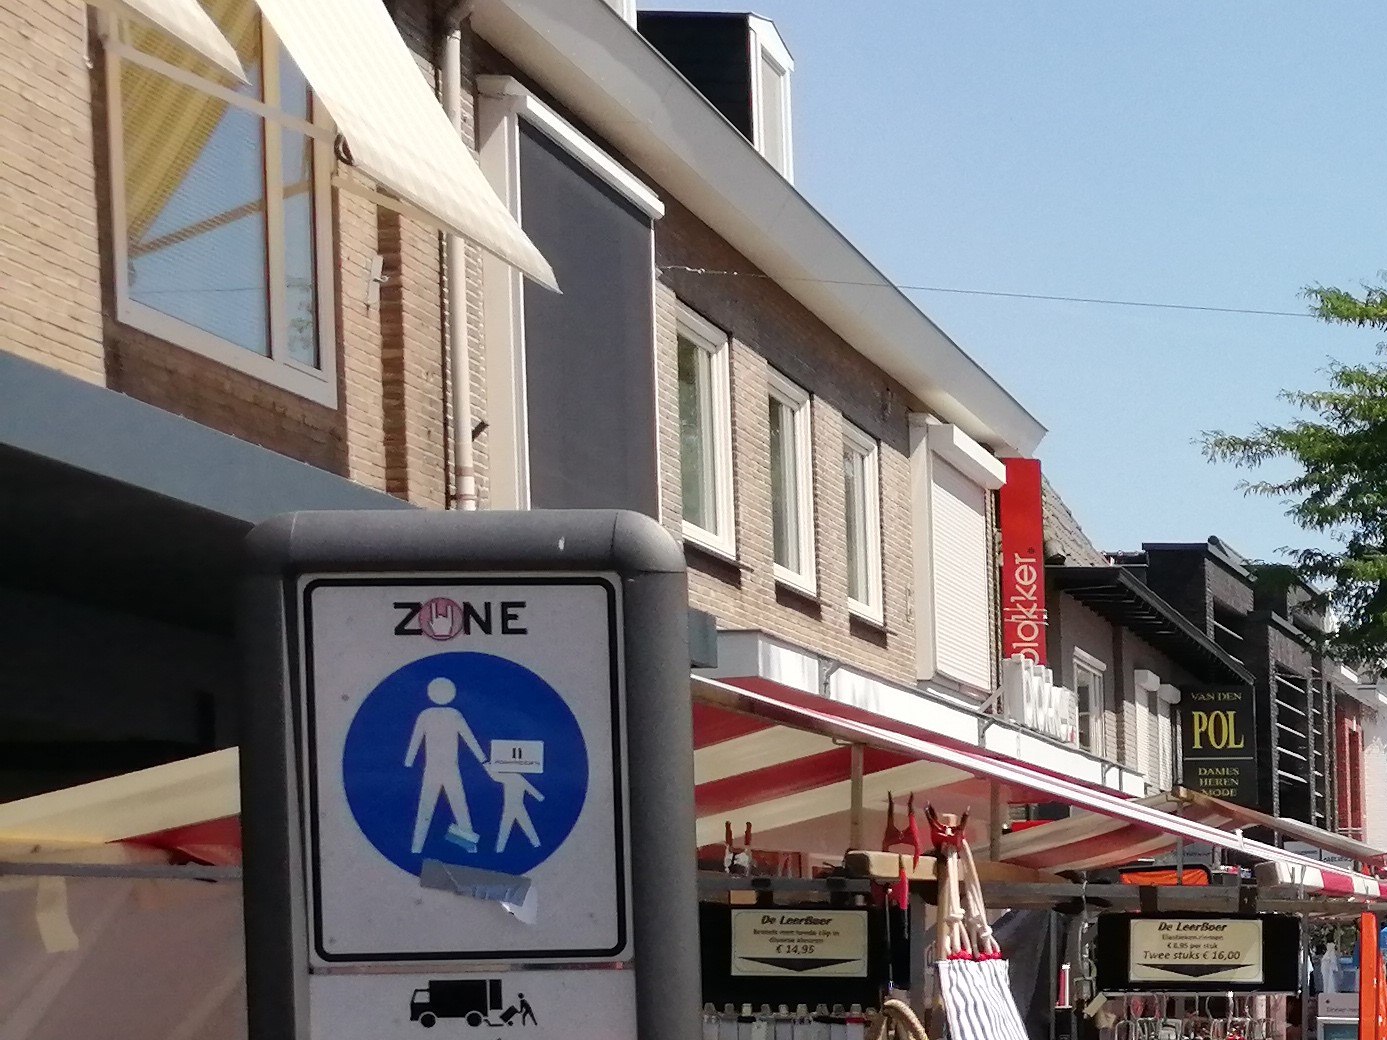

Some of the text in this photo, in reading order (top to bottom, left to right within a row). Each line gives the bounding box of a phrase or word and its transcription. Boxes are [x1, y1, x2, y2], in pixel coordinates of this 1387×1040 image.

[393, 601, 528, 636] ZNE
[1191, 692, 1242, 701] VAN DEN
[1192, 710, 1244, 749] POL
[1198, 767, 1240, 776] DAMES
[1199, 778, 1239, 787] HEREN
[1200, 788, 1237, 798] MODE
[761, 915, 776, 925] De
[1158, 922, 1228, 932] De LeerBoer
[1143, 950, 1171, 960] Twee
[1173, 951, 1200, 960] stuks
[1212, 951, 1241, 961] 16,00
